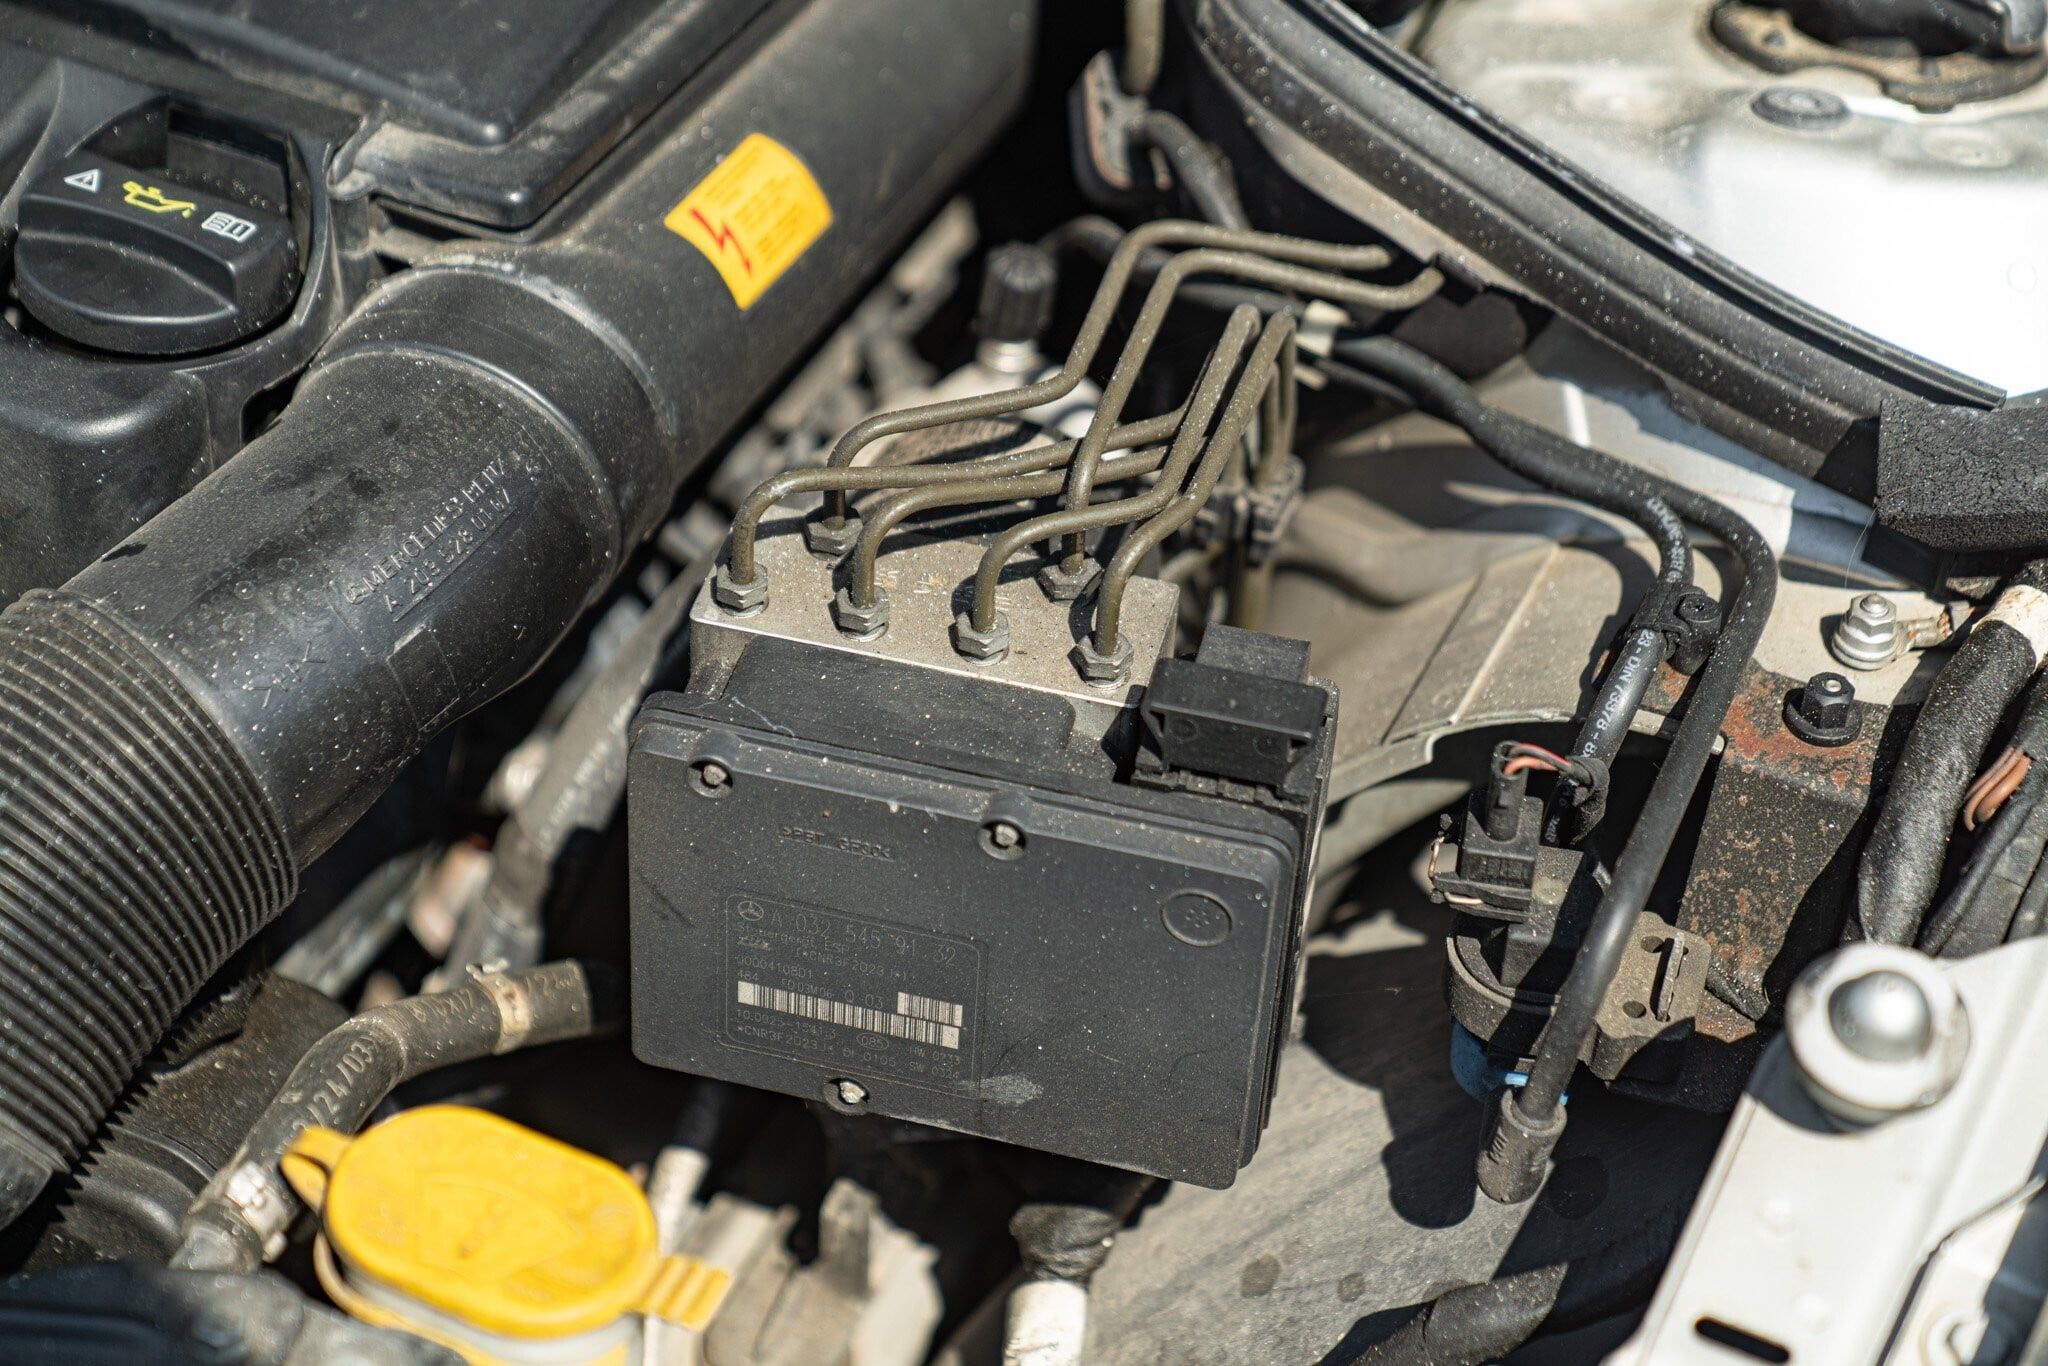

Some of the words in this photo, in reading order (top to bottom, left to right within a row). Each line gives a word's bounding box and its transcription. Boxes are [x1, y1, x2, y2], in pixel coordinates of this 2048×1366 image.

[1618, 655, 1642, 683] DIN
[1595, 683, 1630, 731] 73378
[770, 908, 783, 929] A
[795, 913, 832, 939] 032
[845, 921, 882, 950] 545
[894, 934, 917, 957] 91
[933, 943, 958, 967] 32
[824, 940, 850, 955] ESP
